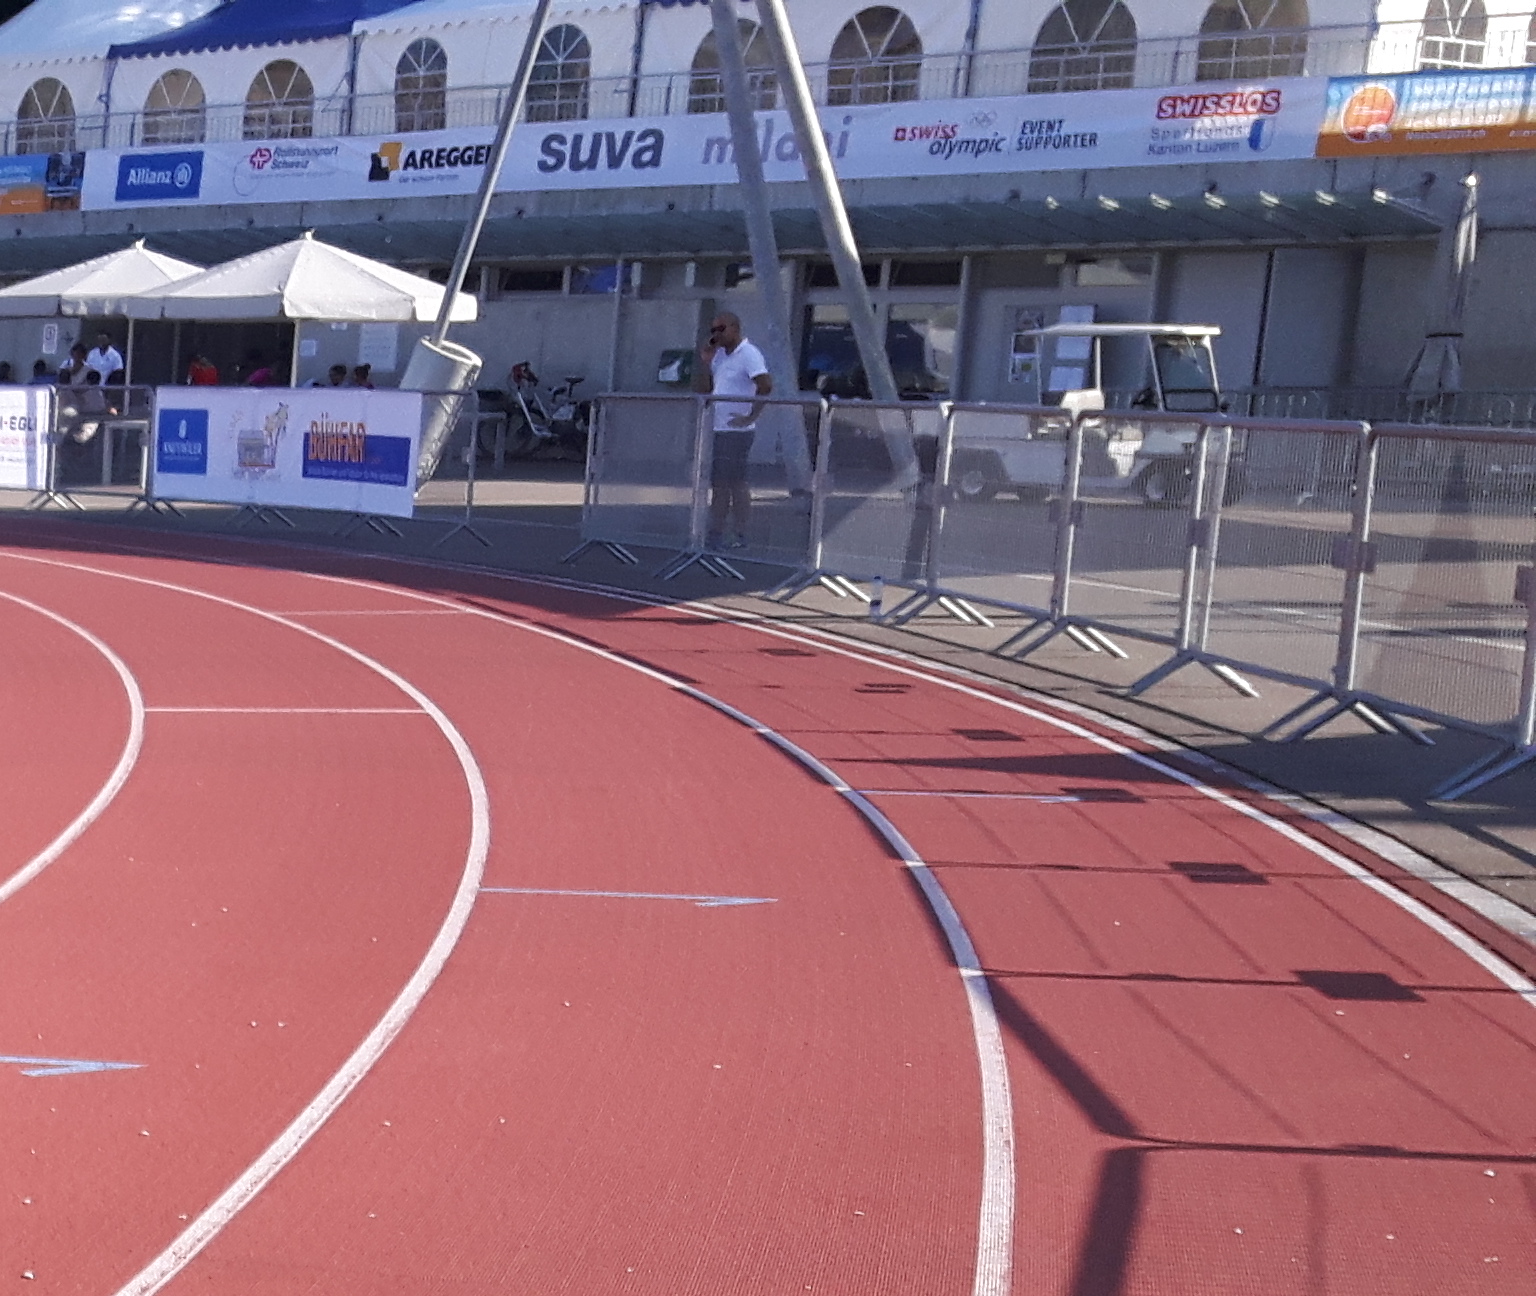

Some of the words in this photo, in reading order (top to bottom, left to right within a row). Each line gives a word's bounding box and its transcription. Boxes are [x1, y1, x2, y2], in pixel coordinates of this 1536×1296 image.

[1158, 91, 1280, 118] SWISSLOS
[909, 120, 959, 140] swiss
[1021, 119, 1065, 136] EVENT
[537, 128, 664, 173] suva
[929, 132, 1007, 160] olympic
[1016, 132, 1098, 152] SUPPORTER
[127, 167, 172, 185] Allianz
